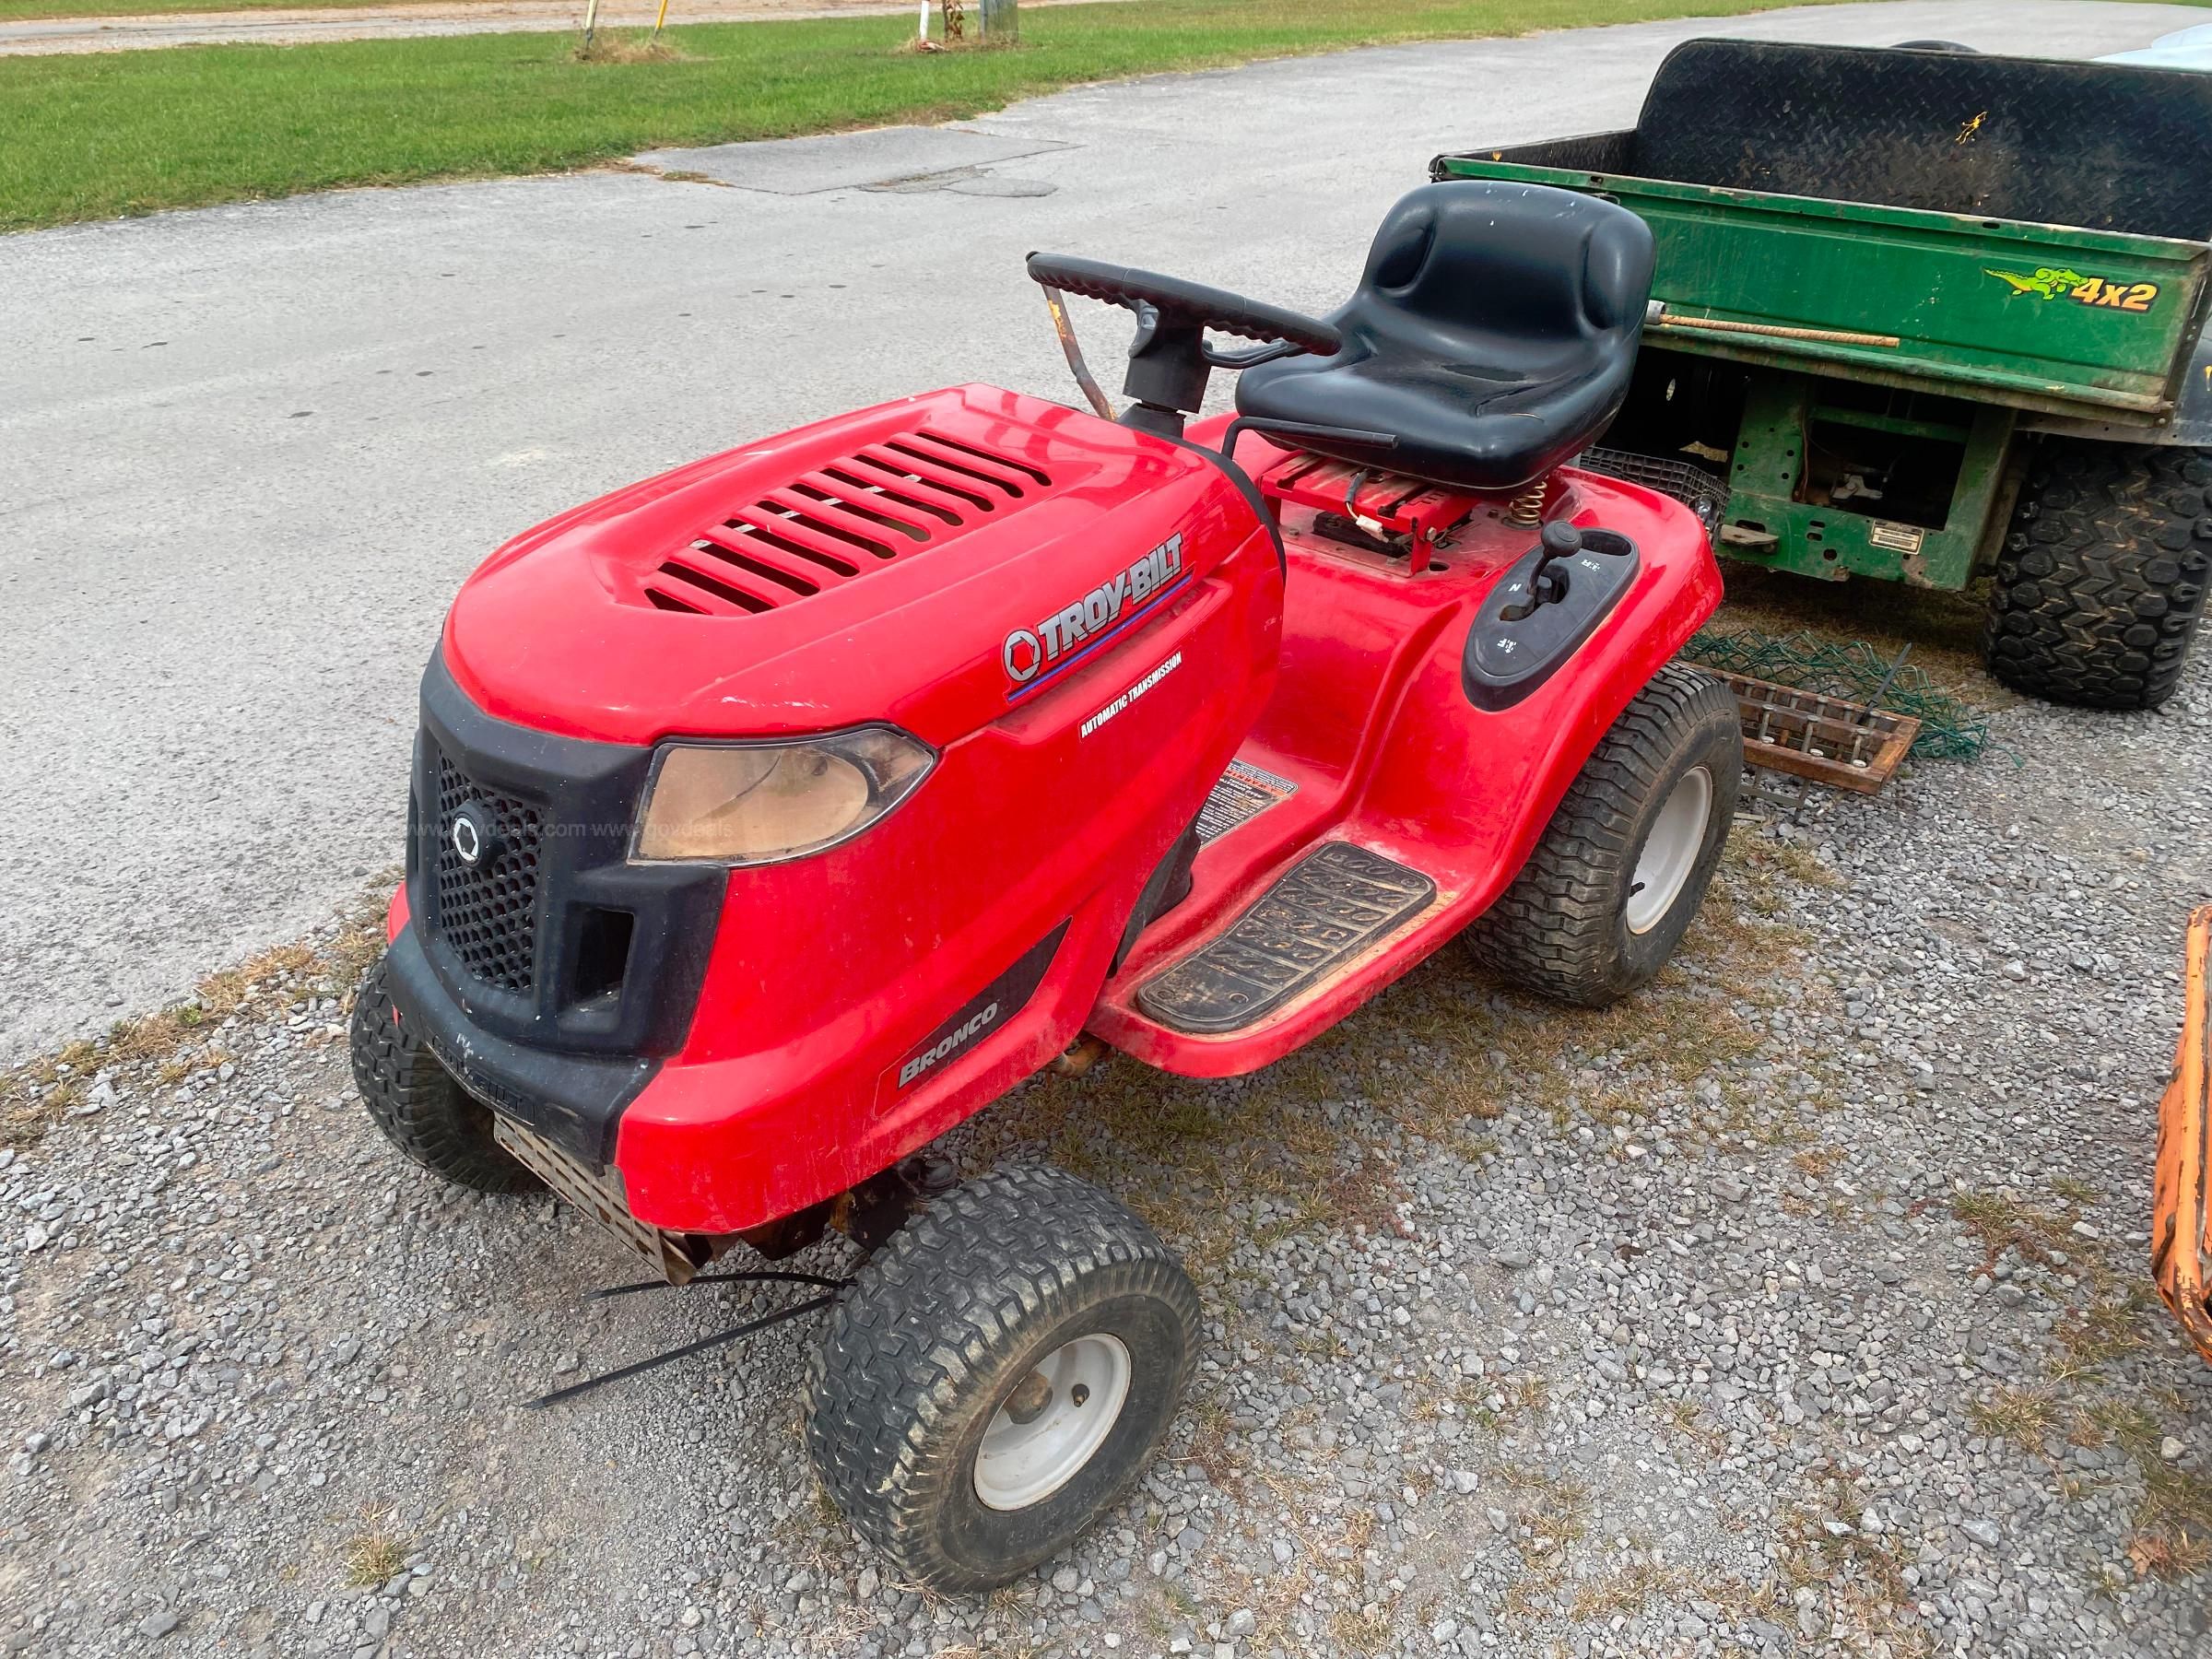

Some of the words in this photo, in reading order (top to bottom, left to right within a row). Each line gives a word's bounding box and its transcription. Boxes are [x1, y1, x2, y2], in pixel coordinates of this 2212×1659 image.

[2070, 277, 2158, 312] 4x2
[1038, 532, 1184, 661] TROY-BILT
[1508, 583, 1522, 593] N
[1080, 694, 1128, 739] AUTOMATIC
[1127, 651, 1182, 704] TRANSMISSION
[1225, 770, 1266, 788] WARNIN
[898, 1002, 998, 1088] BRONCO
